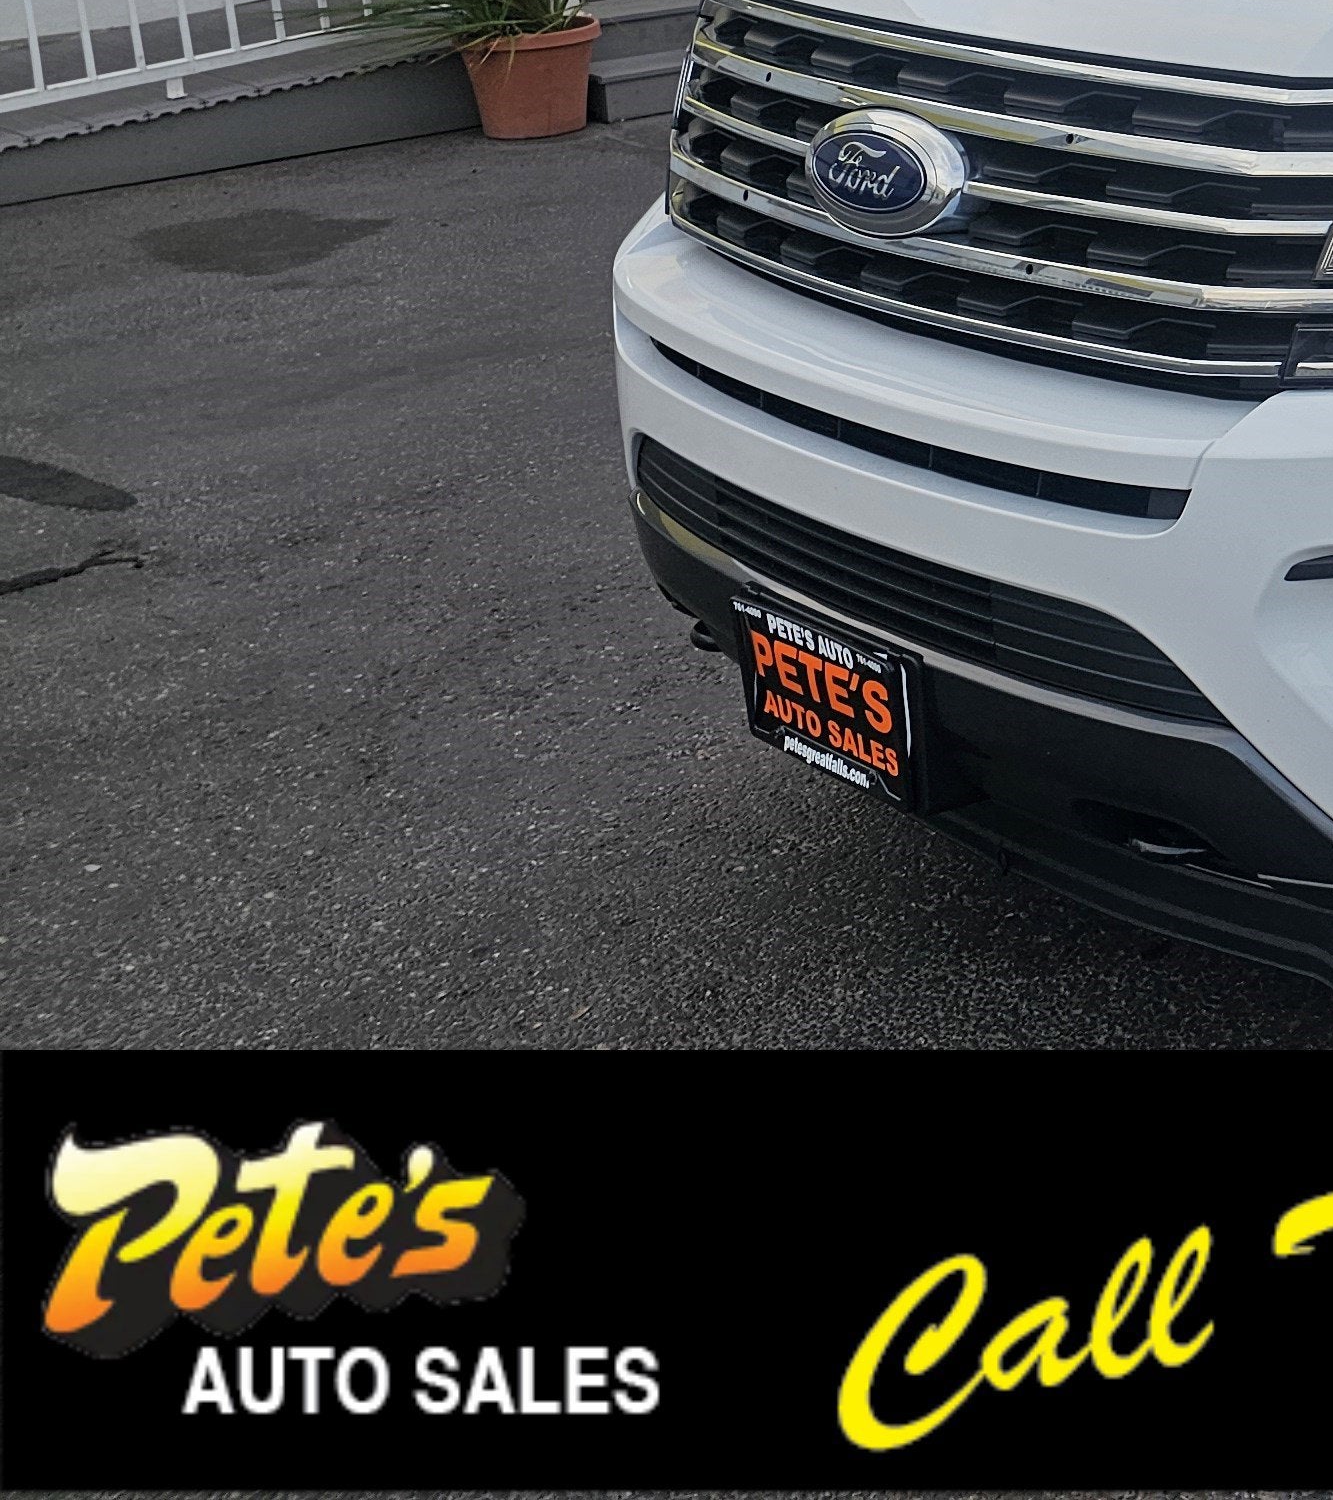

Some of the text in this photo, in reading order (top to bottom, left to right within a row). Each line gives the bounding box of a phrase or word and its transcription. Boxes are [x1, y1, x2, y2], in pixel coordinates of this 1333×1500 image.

[828, 141, 900, 199] Ford
[766, 613, 815, 651] PETE'S
[818, 635, 854, 670] AUTO
[751, 630, 893, 734] PETE'S
[764, 690, 899, 777] AUTO SALES
